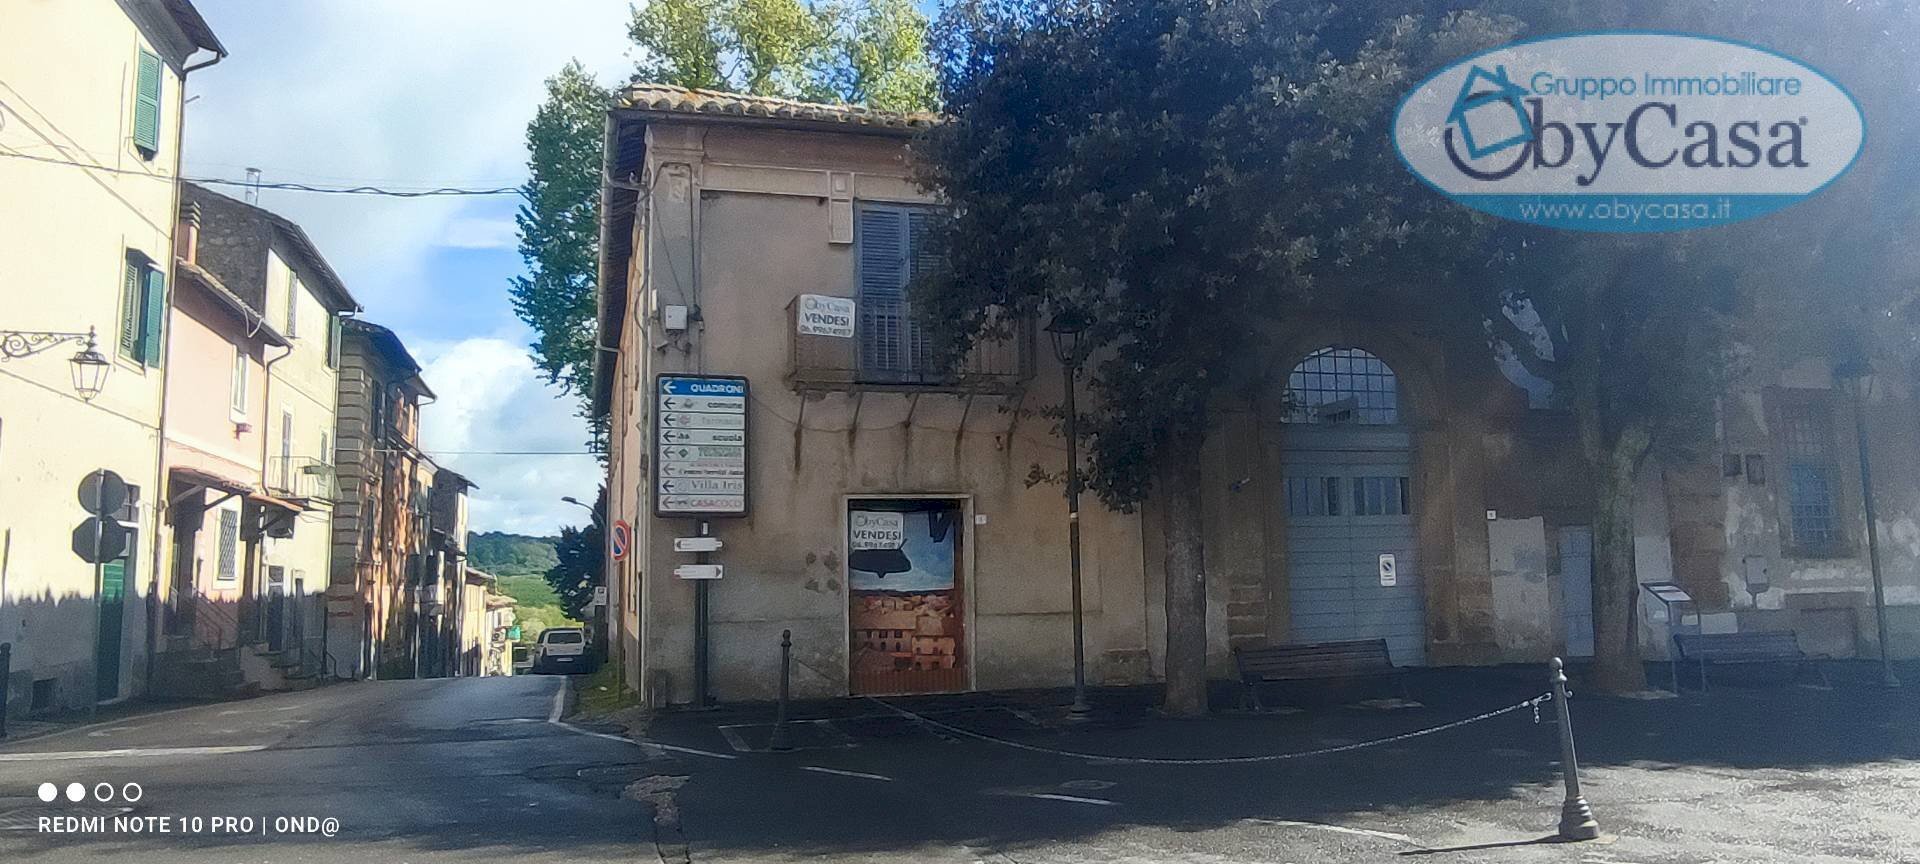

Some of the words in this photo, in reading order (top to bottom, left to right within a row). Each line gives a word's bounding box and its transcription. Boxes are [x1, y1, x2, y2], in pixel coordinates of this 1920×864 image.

[804, 312, 850, 327] VENDESI
[690, 384, 744, 394] QUADRONI
[708, 401, 743, 410] comune
[712, 433, 743, 442] scuola
[691, 479, 719, 490] Villa
[722, 479, 743, 490] Iris
[853, 530, 901, 540] VENDESI
